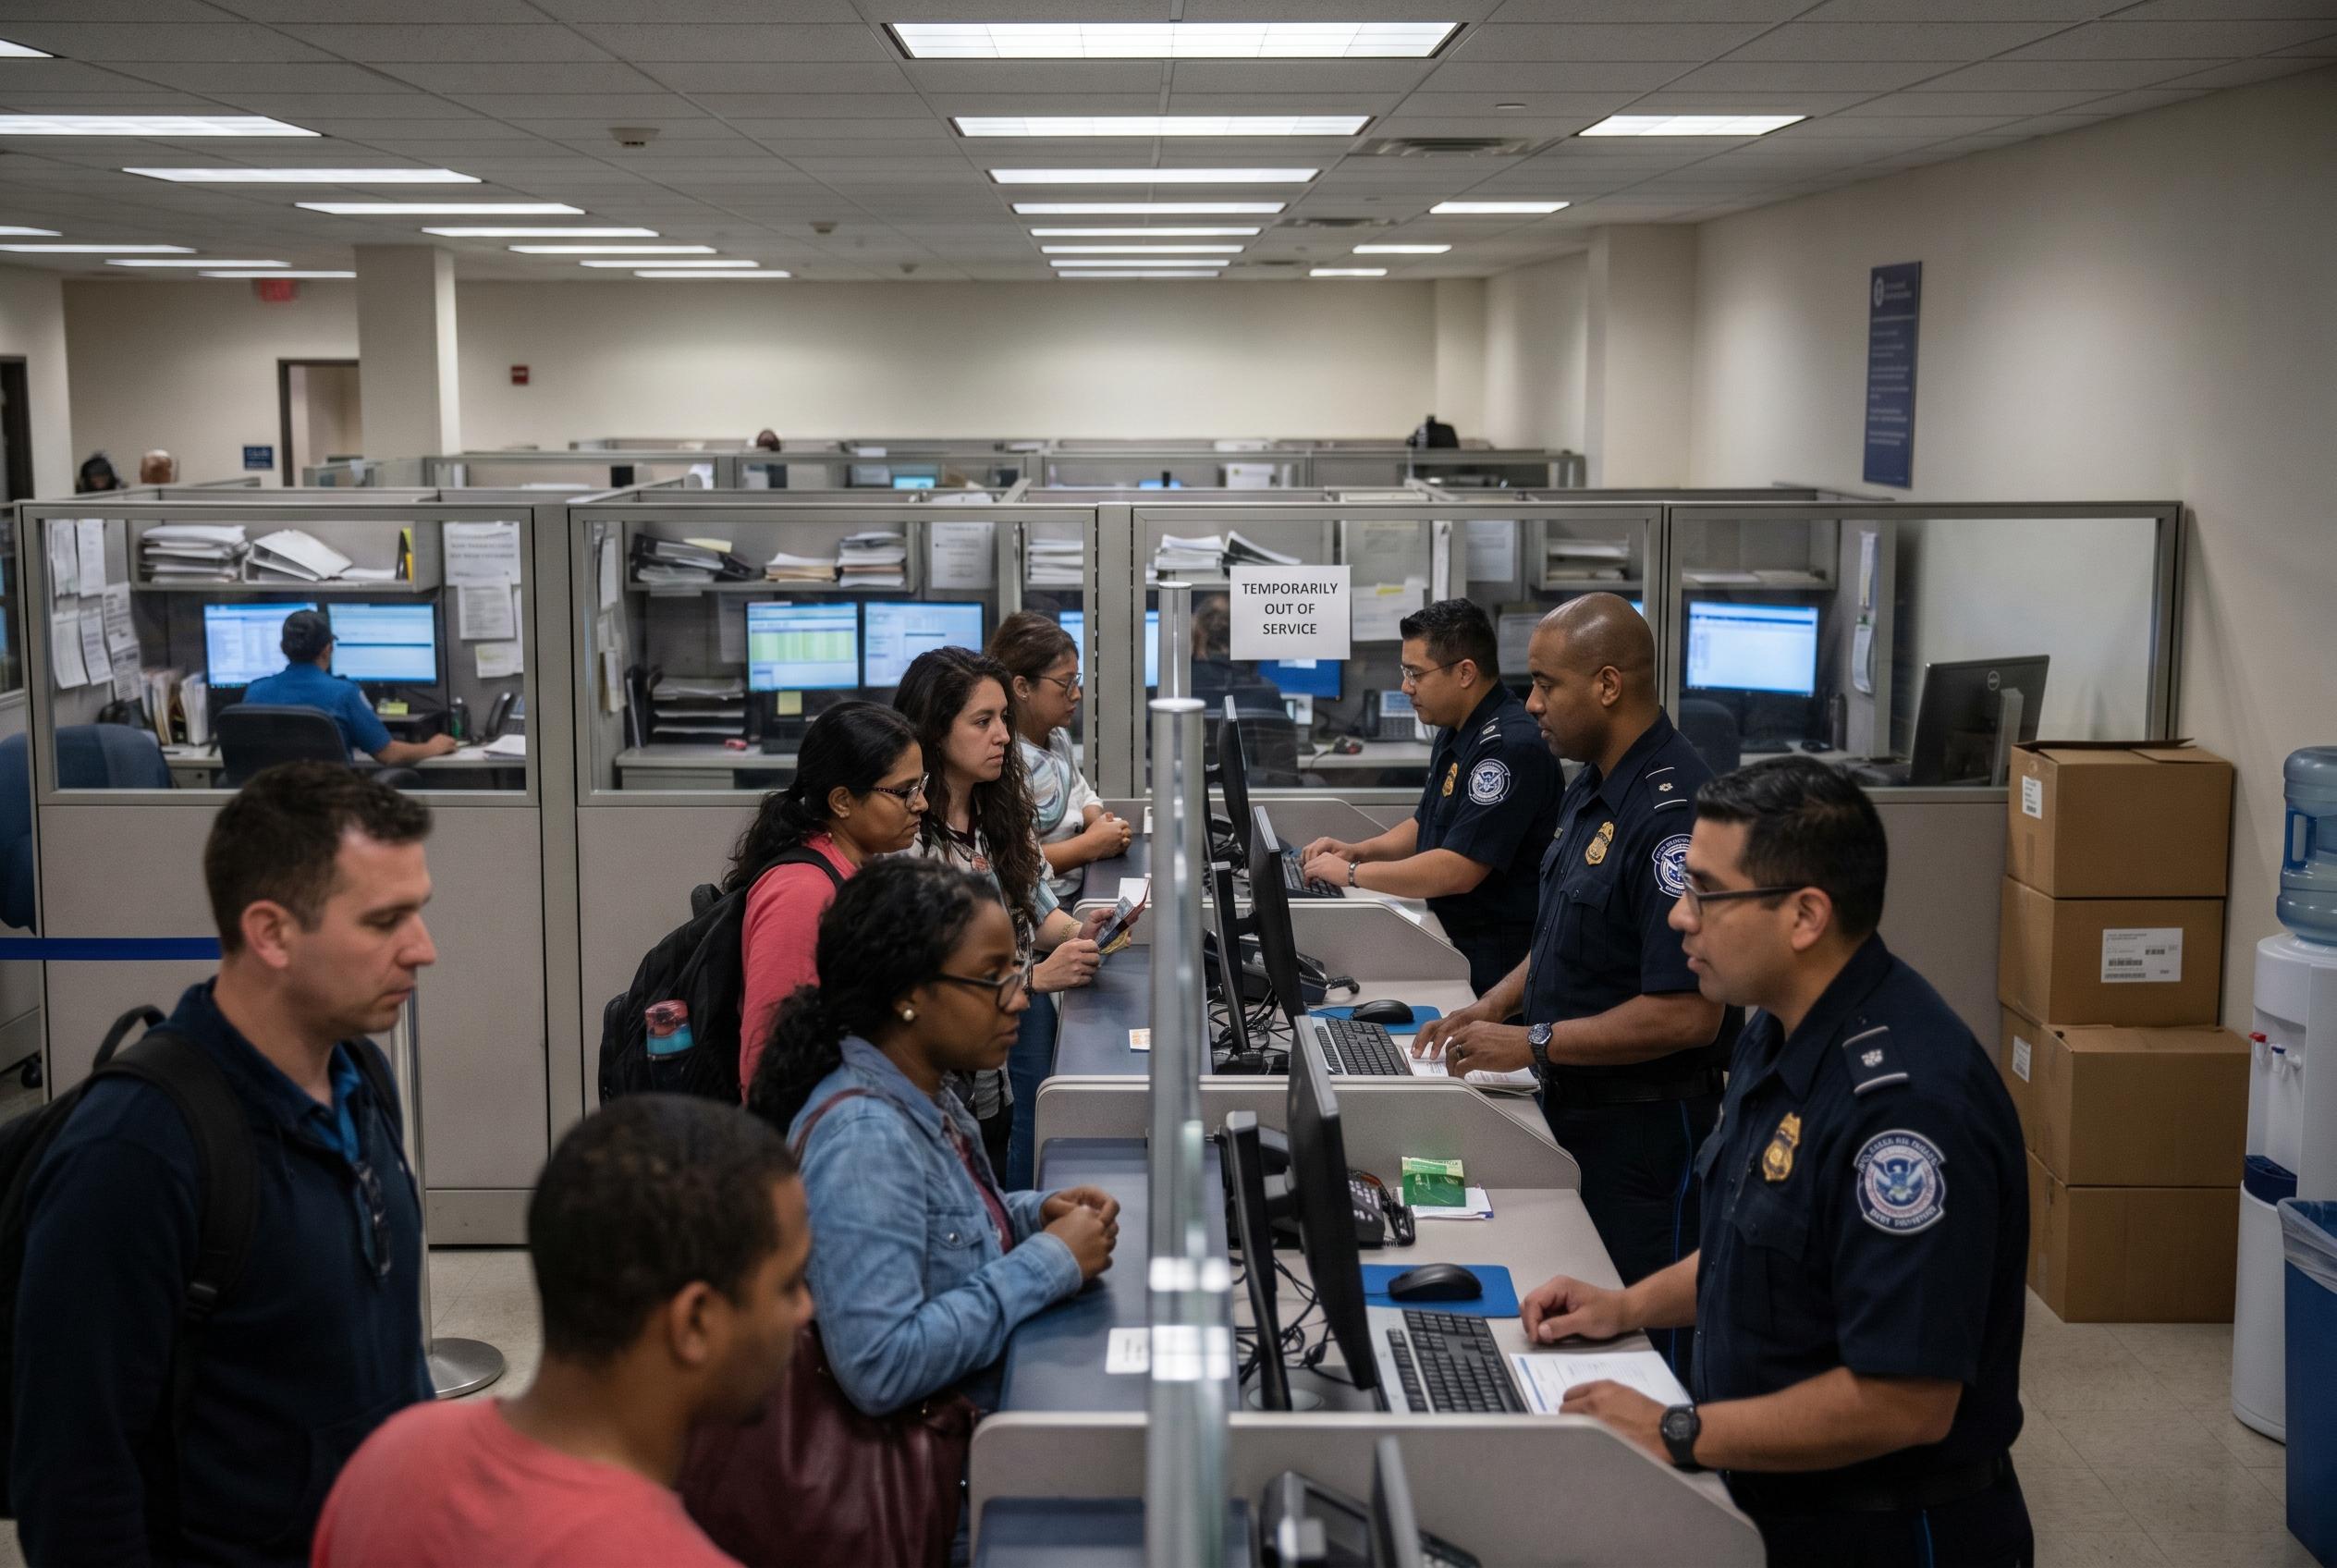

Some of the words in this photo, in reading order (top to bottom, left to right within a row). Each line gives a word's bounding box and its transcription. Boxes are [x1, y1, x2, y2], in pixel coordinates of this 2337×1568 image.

[1242, 582, 1338, 594] TEMPORARILY
[1265, 603, 1293, 615] OUT
[1297, 603, 1315, 615] OF
[1263, 623, 1316, 635] SERVICE
